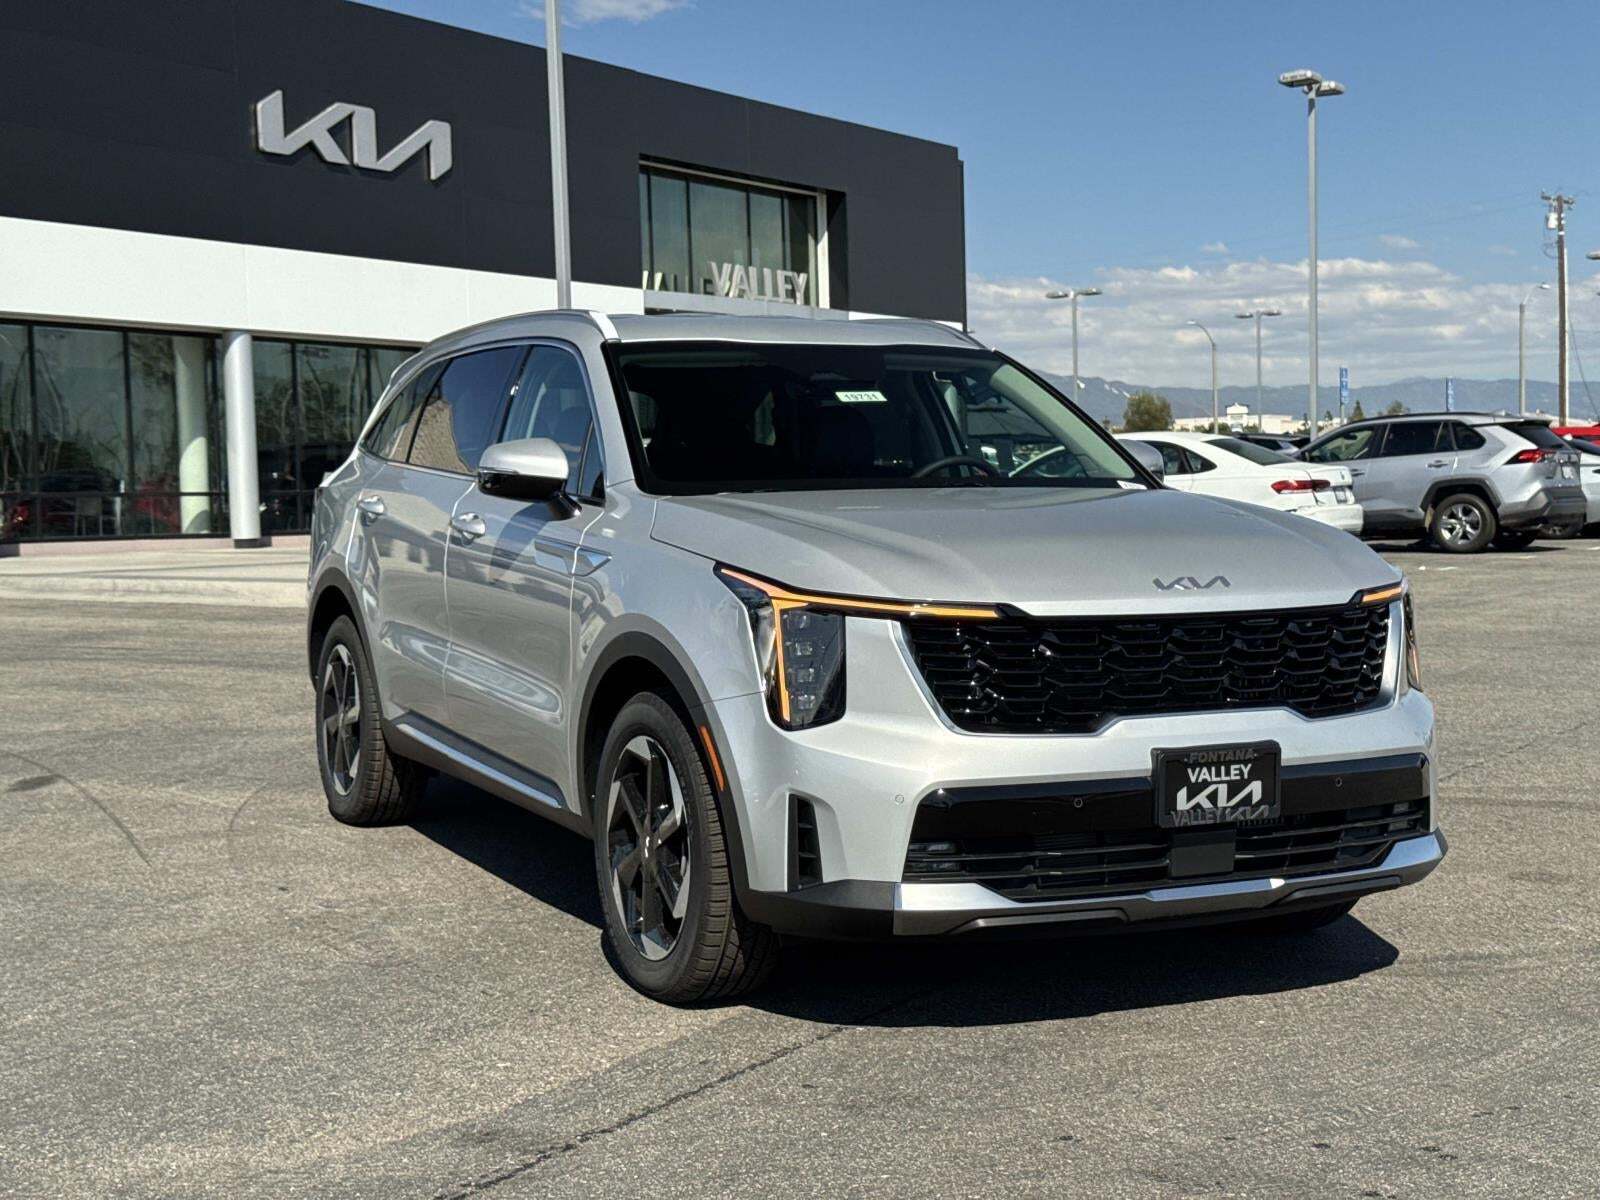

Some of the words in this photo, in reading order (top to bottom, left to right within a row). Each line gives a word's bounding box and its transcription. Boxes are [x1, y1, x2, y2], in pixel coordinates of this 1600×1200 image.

[257, 89, 453, 181] KIA
[709, 261, 808, 305] VALLEY
[1153, 575, 1231, 591] KIA
[1189, 749, 1255, 764] FONTANA
[1187, 763, 1252, 784] VALLEY
[1176, 780, 1262, 811] KIA
[1171, 805, 1222, 828] VALLEY
